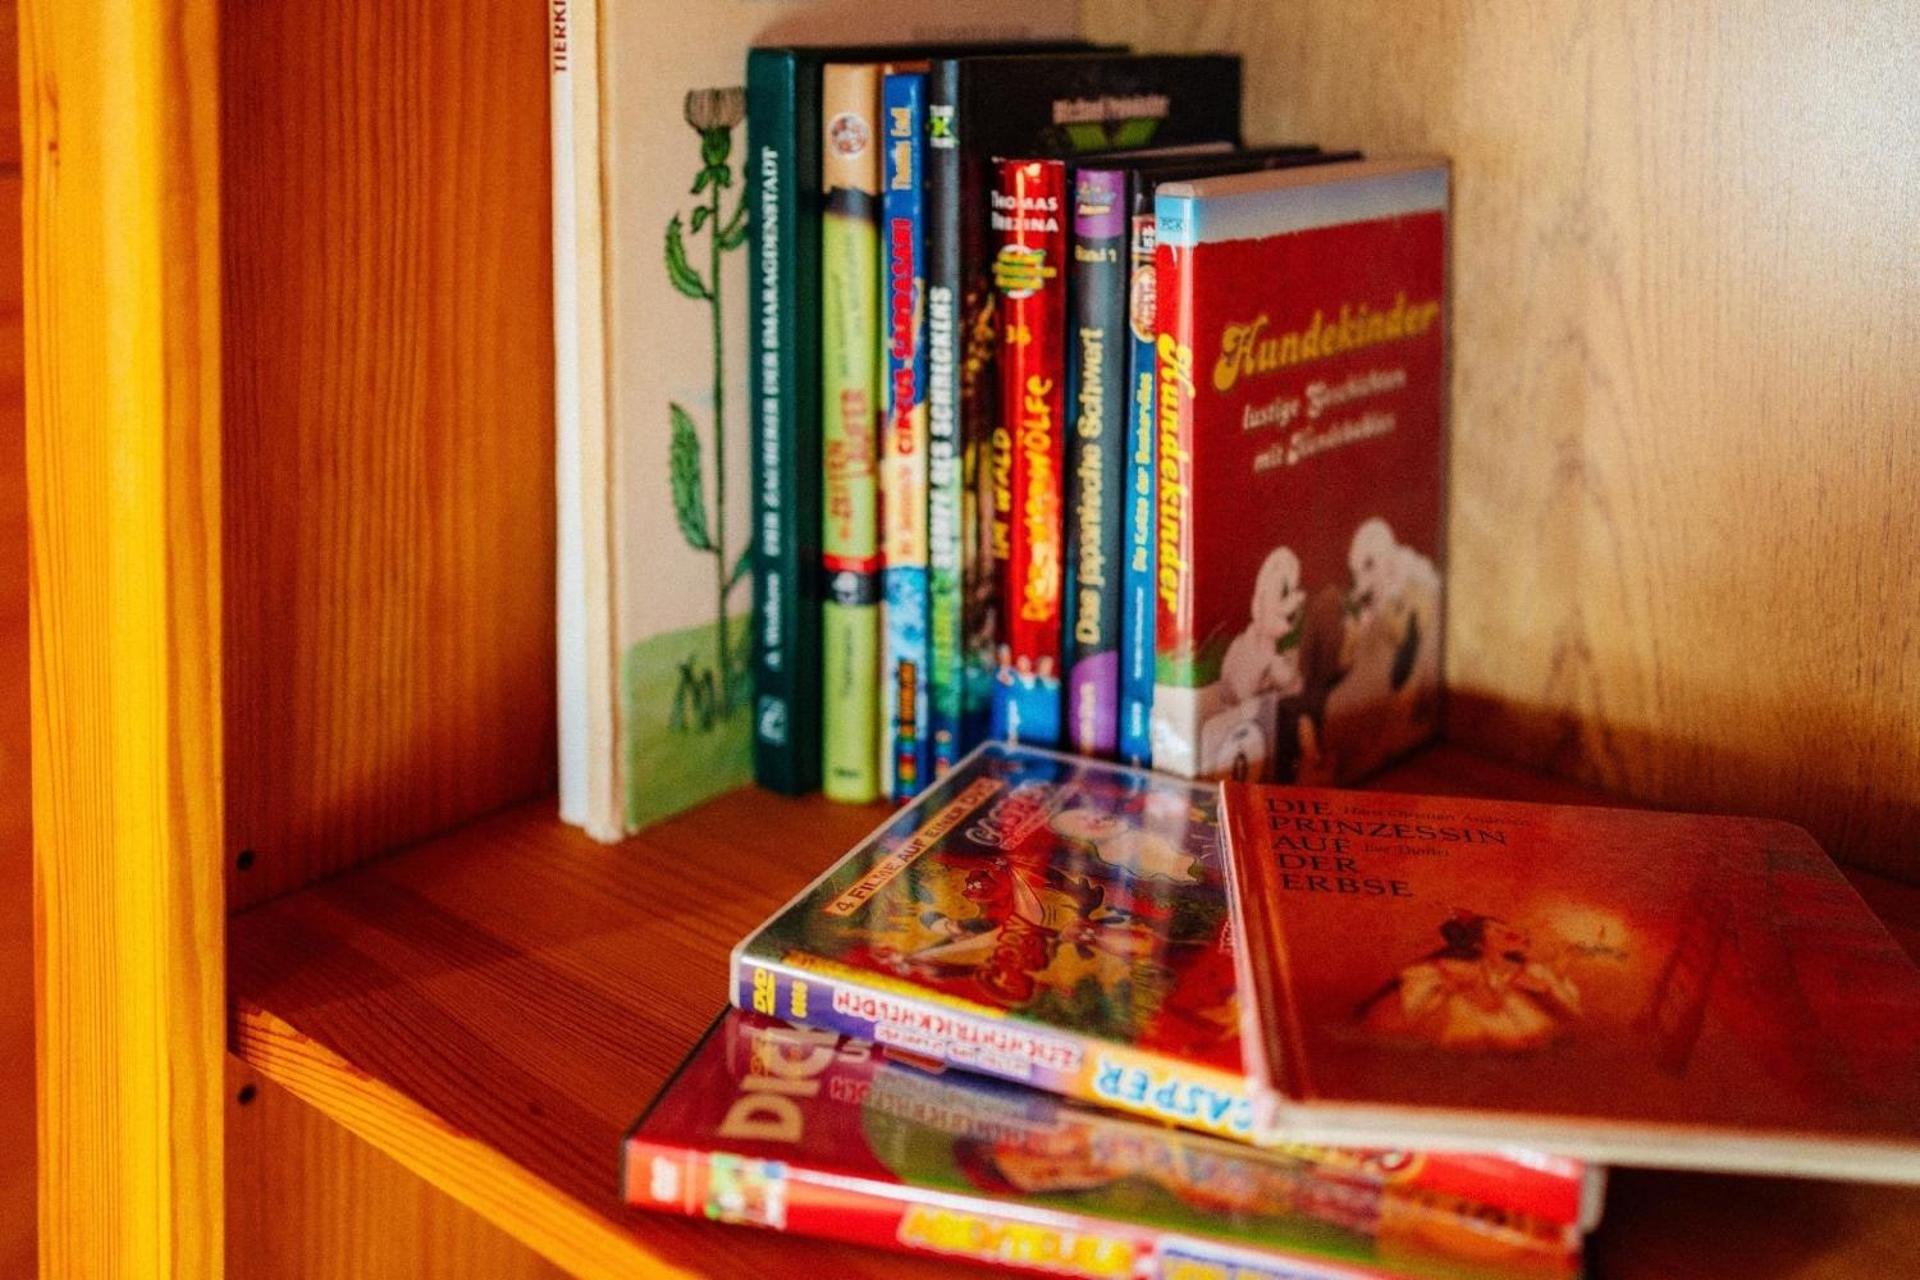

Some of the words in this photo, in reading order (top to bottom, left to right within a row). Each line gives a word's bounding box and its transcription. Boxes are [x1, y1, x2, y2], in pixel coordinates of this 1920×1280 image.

[762, 147, 779, 348] SMARAGDENSTADT
[930, 288, 953, 438] SCHRECKENS
[1214, 291, 1439, 391] Hundekinder
[1077, 327, 1104, 438] Schwert
[992, 427, 1011, 513] WALD
[1158, 332, 1196, 614] Hundekinder
[1077, 444, 1106, 587] japanische
[1076, 590, 1101, 644] Das
[1267, 799, 1331, 816] DIE
[1270, 816, 1506, 845] PRINZESSIN
[1273, 835, 1351, 853] AUF
[836, 897, 852, 912] 4
[848, 862, 901, 902] FILME
[897, 838, 926, 867] AUF
[1278, 854, 1358, 874] DER
[1281, 874, 1415, 898] ERBSE
[1099, 1062, 1253, 1130] CASPER
